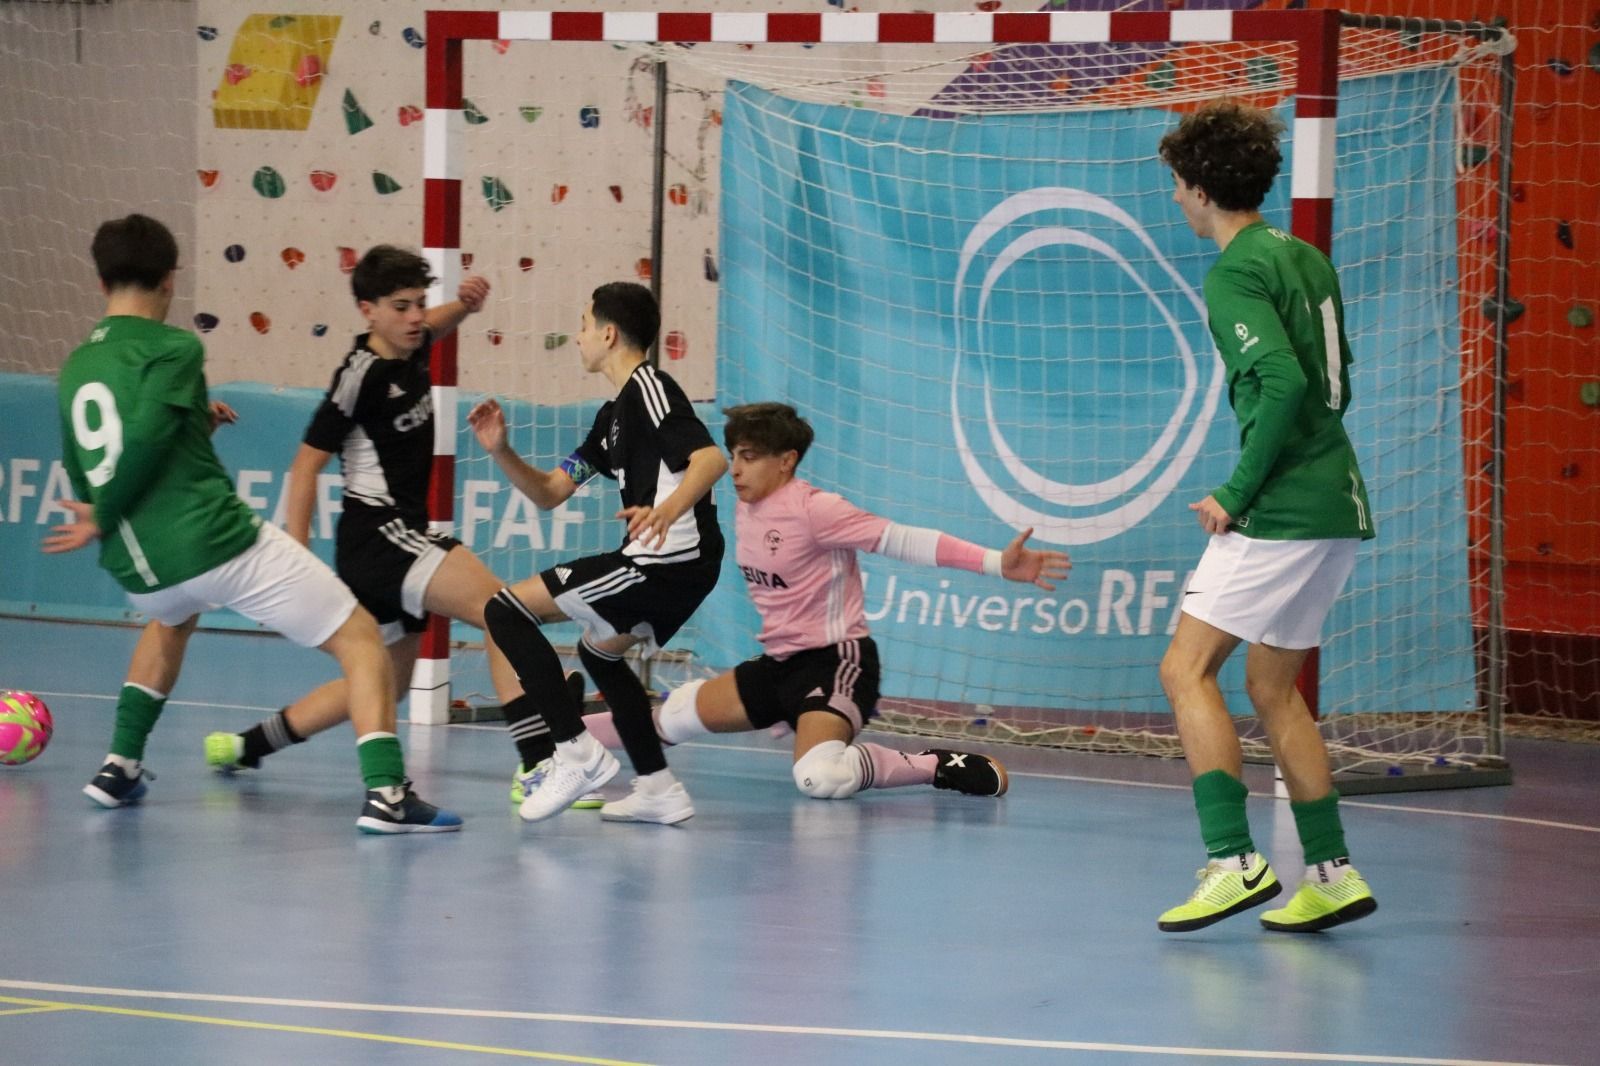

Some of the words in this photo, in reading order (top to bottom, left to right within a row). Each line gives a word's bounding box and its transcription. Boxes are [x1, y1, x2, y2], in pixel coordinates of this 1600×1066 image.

[71, 382, 123, 488] 9
[0, 458, 76, 525] FA
[739, 564, 789, 590] EUTA
